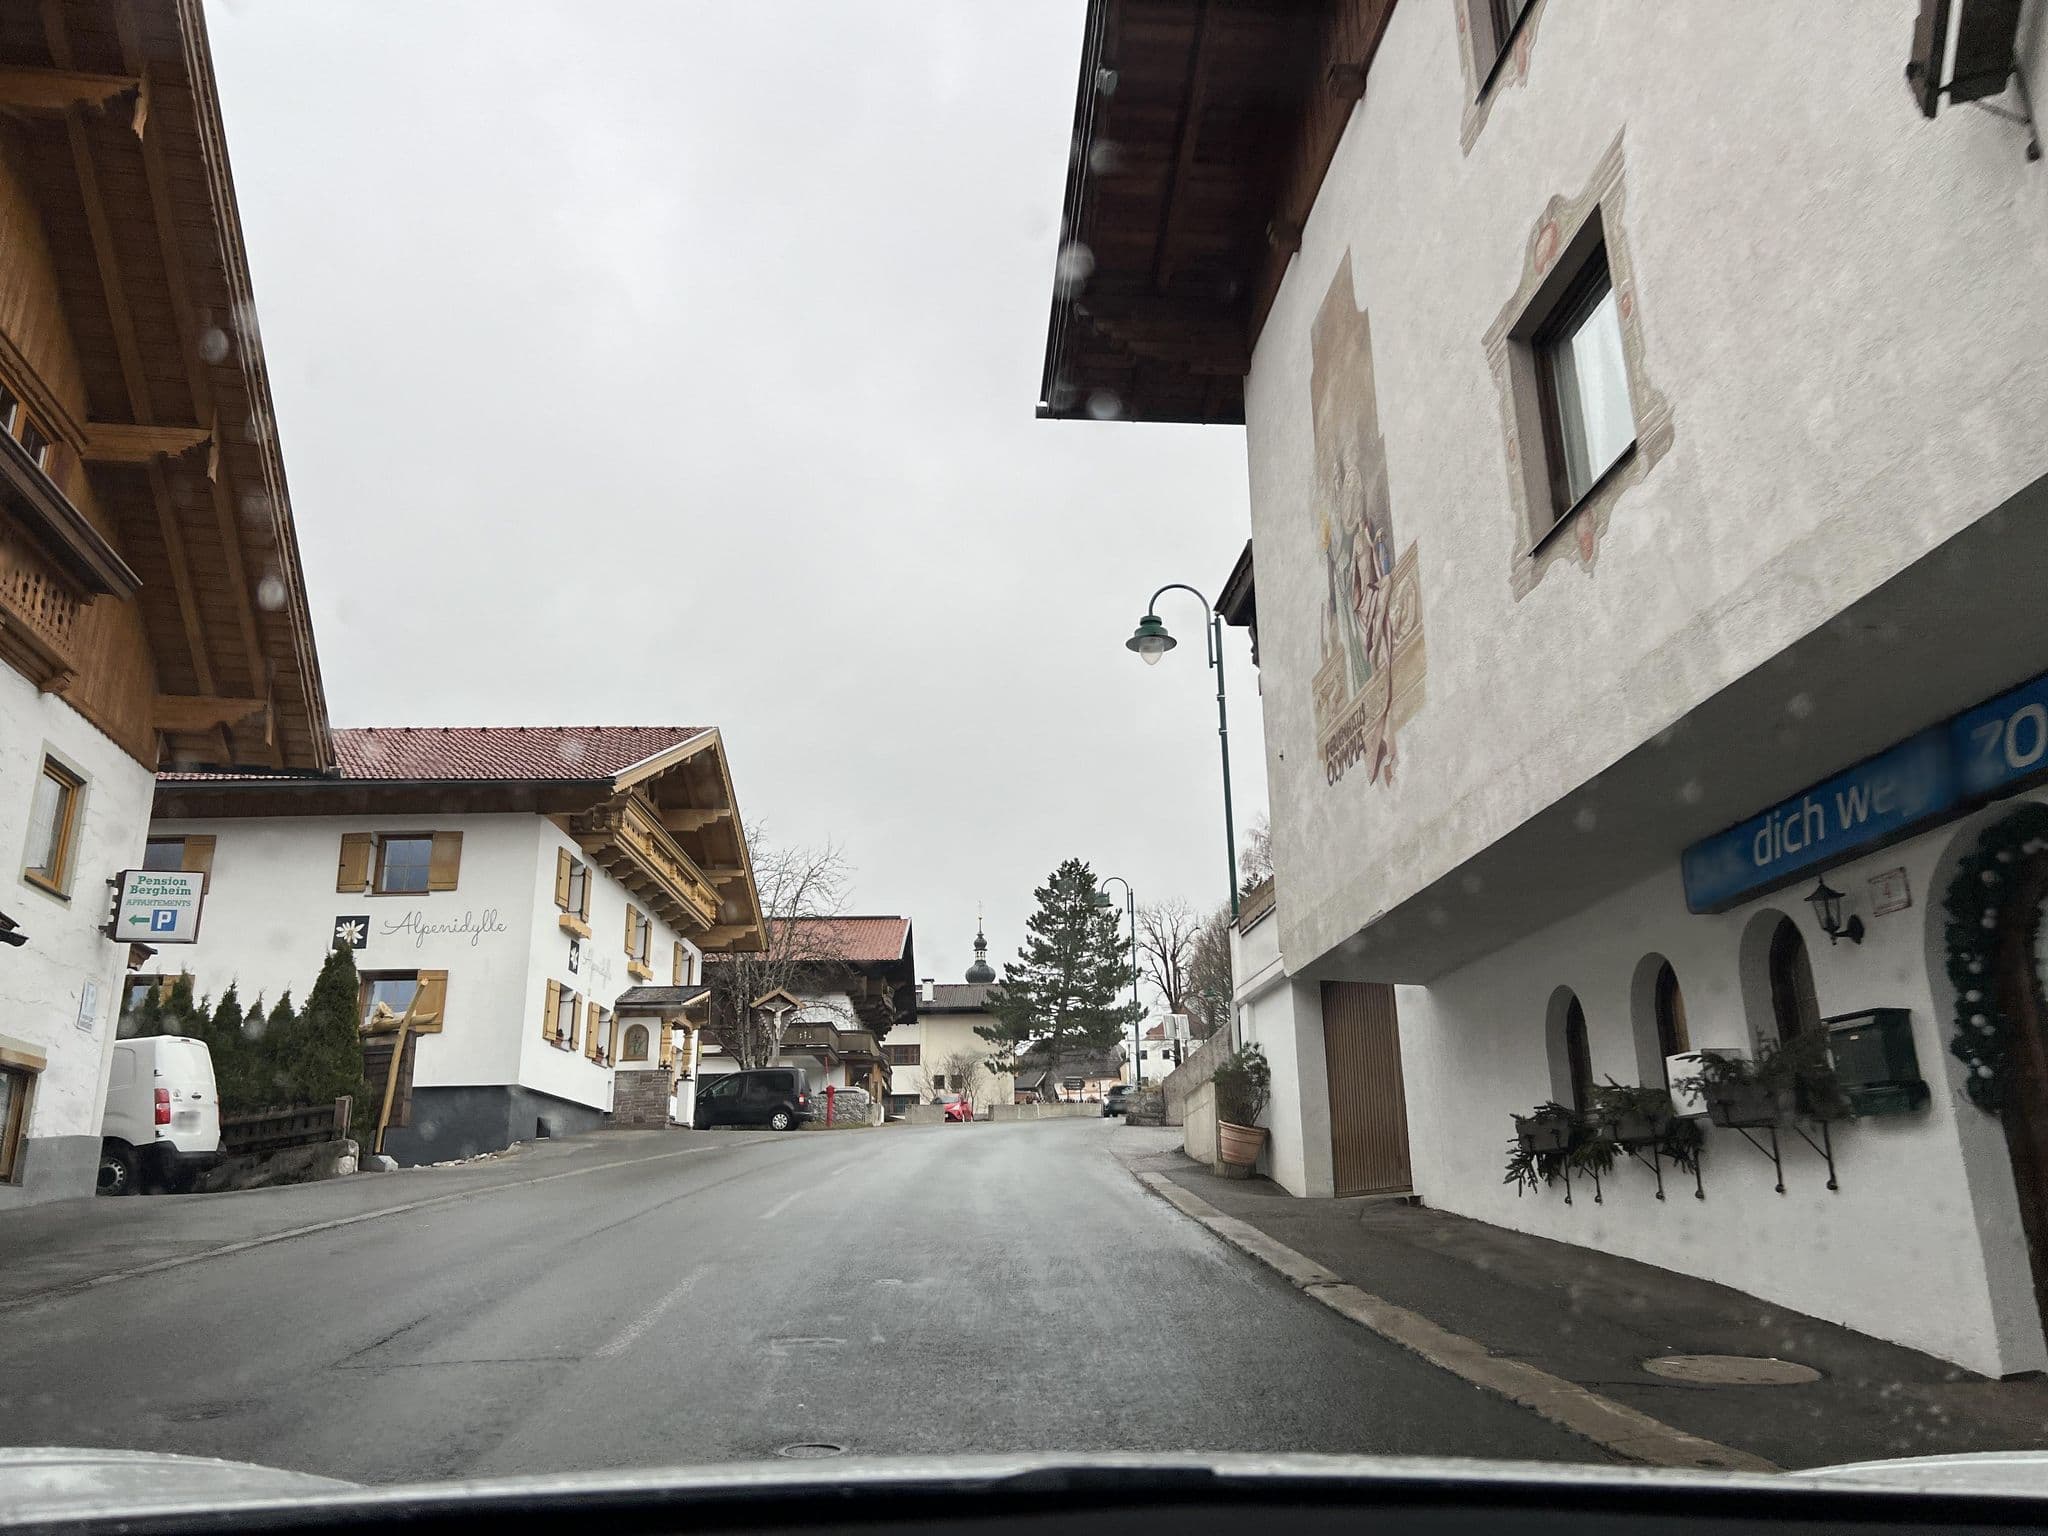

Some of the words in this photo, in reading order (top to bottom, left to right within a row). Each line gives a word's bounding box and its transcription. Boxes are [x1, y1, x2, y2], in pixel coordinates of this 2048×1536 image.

[1753, 795, 1825, 867] dich
[137, 876, 187, 886] Pension
[130, 885, 191, 896] Bergheim
[157, 911, 172, 929] P
[380, 909, 507, 948] Alpenidylle
